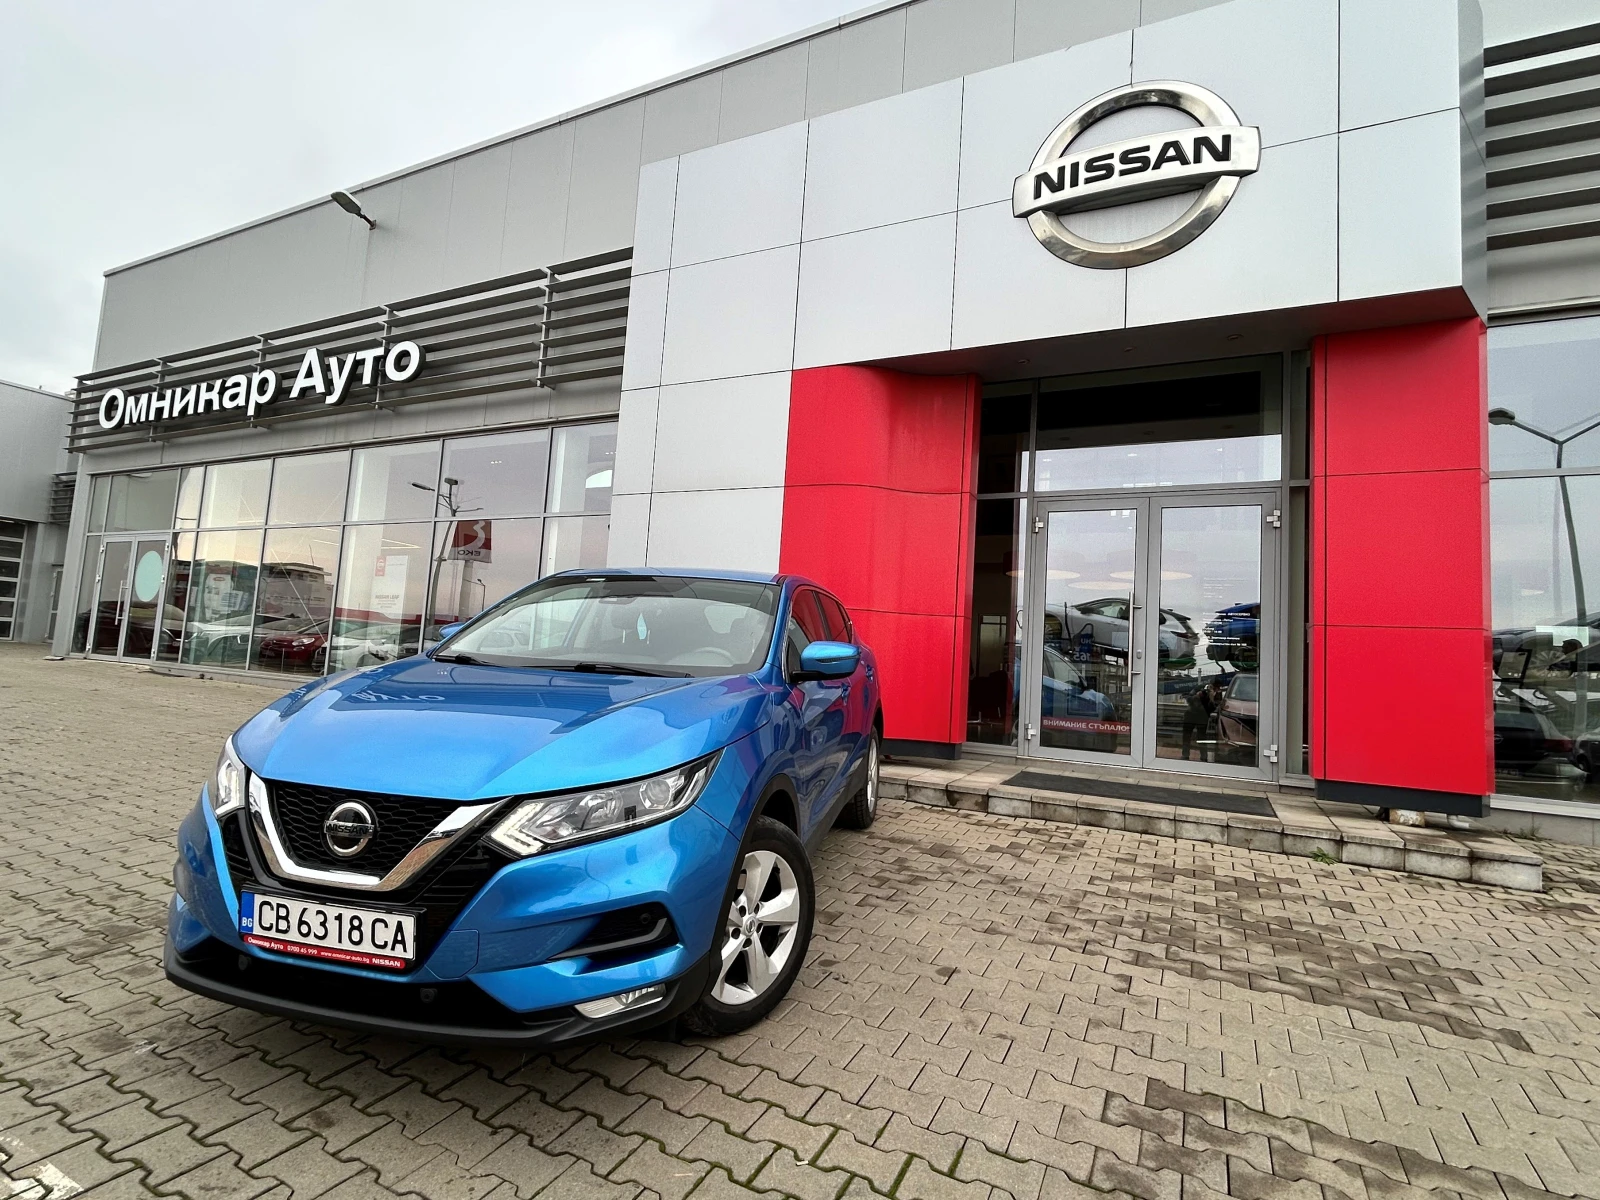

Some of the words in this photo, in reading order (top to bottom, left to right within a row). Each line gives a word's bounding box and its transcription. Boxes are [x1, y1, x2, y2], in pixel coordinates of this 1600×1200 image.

[1033, 134, 1231, 199] NISSAN
[98, 367, 277, 429] Омникар
[289, 341, 422, 404] Ауто
[1043, 719, 1086, 729] ВНИМАНИЕ
[326, 823, 369, 835] NISSAN
[242, 917, 253, 928] BG
[297, 907, 364, 946] 6318
[287, 945, 300, 953] 0700
[372, 958, 400, 967] NISSAN
